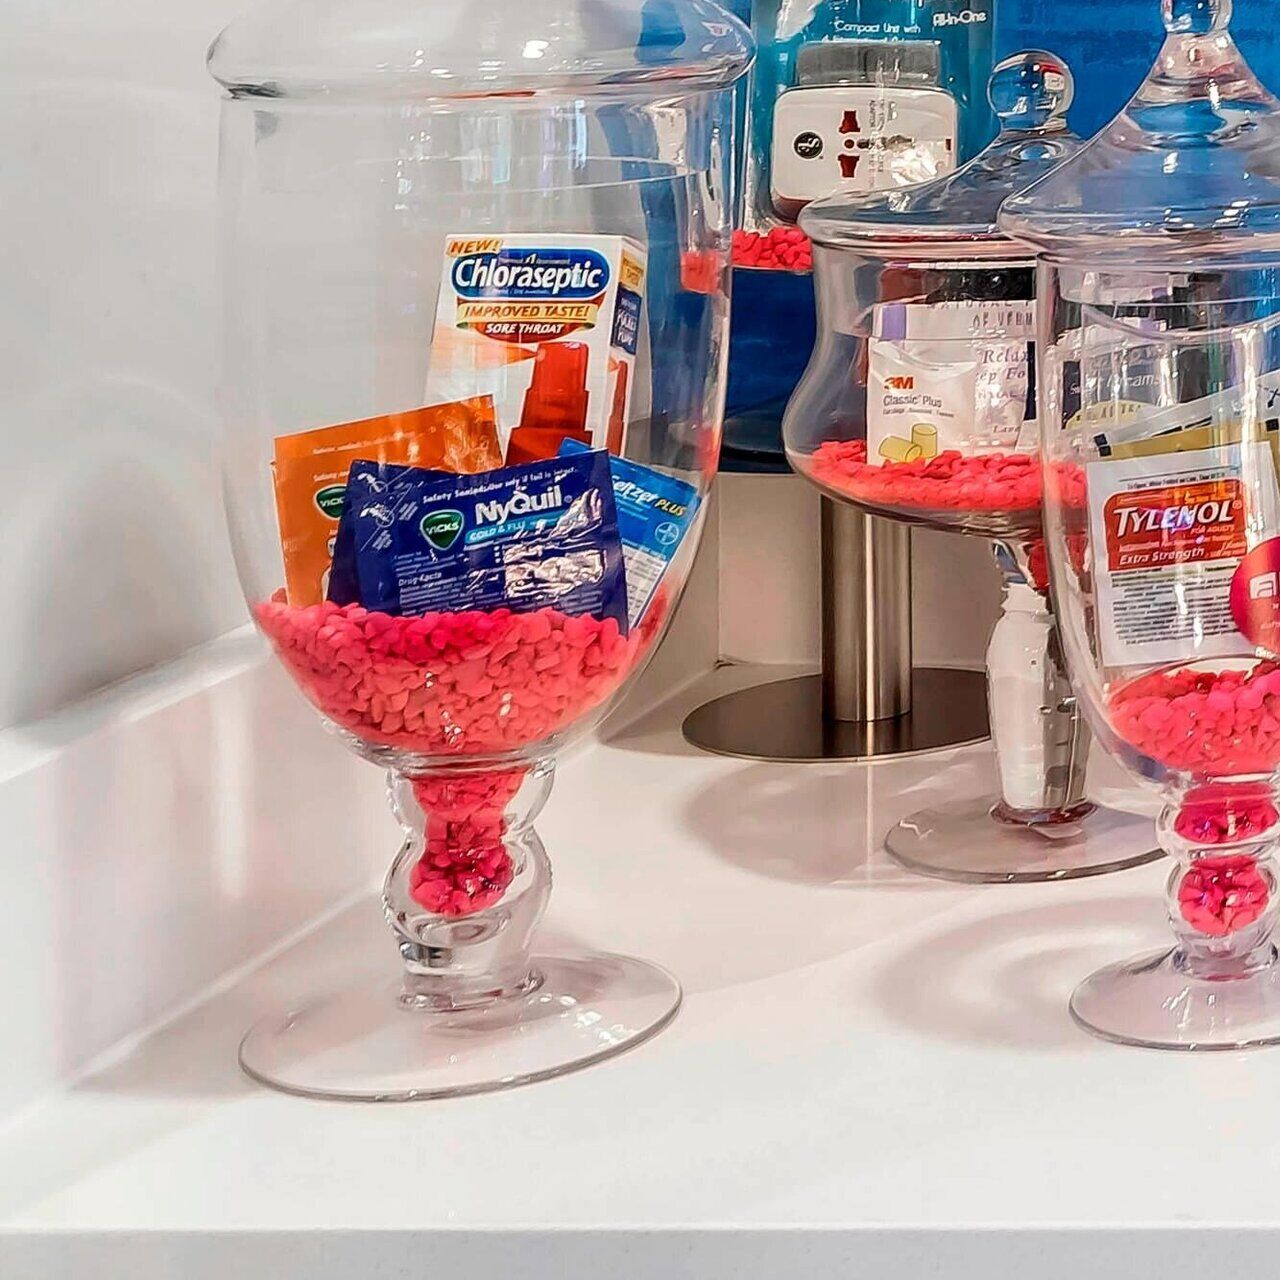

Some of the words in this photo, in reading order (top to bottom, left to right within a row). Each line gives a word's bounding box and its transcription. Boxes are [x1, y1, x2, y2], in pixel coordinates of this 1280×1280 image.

[450, 239, 498, 255] NEW!
[455, 257, 603, 295] Chloraseptic
[464, 304, 543, 319] IMPROVED
[544, 304, 591, 317] TASTE!
[486, 323, 517, 334] SORE
[518, 323, 565, 335] THROAT
[883, 376, 915, 390] 3M
[883, 394, 919, 407] Classic
[922, 395, 943, 408] Plus
[474, 485, 563, 525] NyQuil
[655, 497, 688, 517] PLUS
[1112, 499, 1235, 539] TYLENOL
[425, 522, 460, 536] VICKS
[469, 526, 497, 541] COLD
[1119, 553, 1150, 566] Extra
[1151, 547, 1205, 563] Strength
